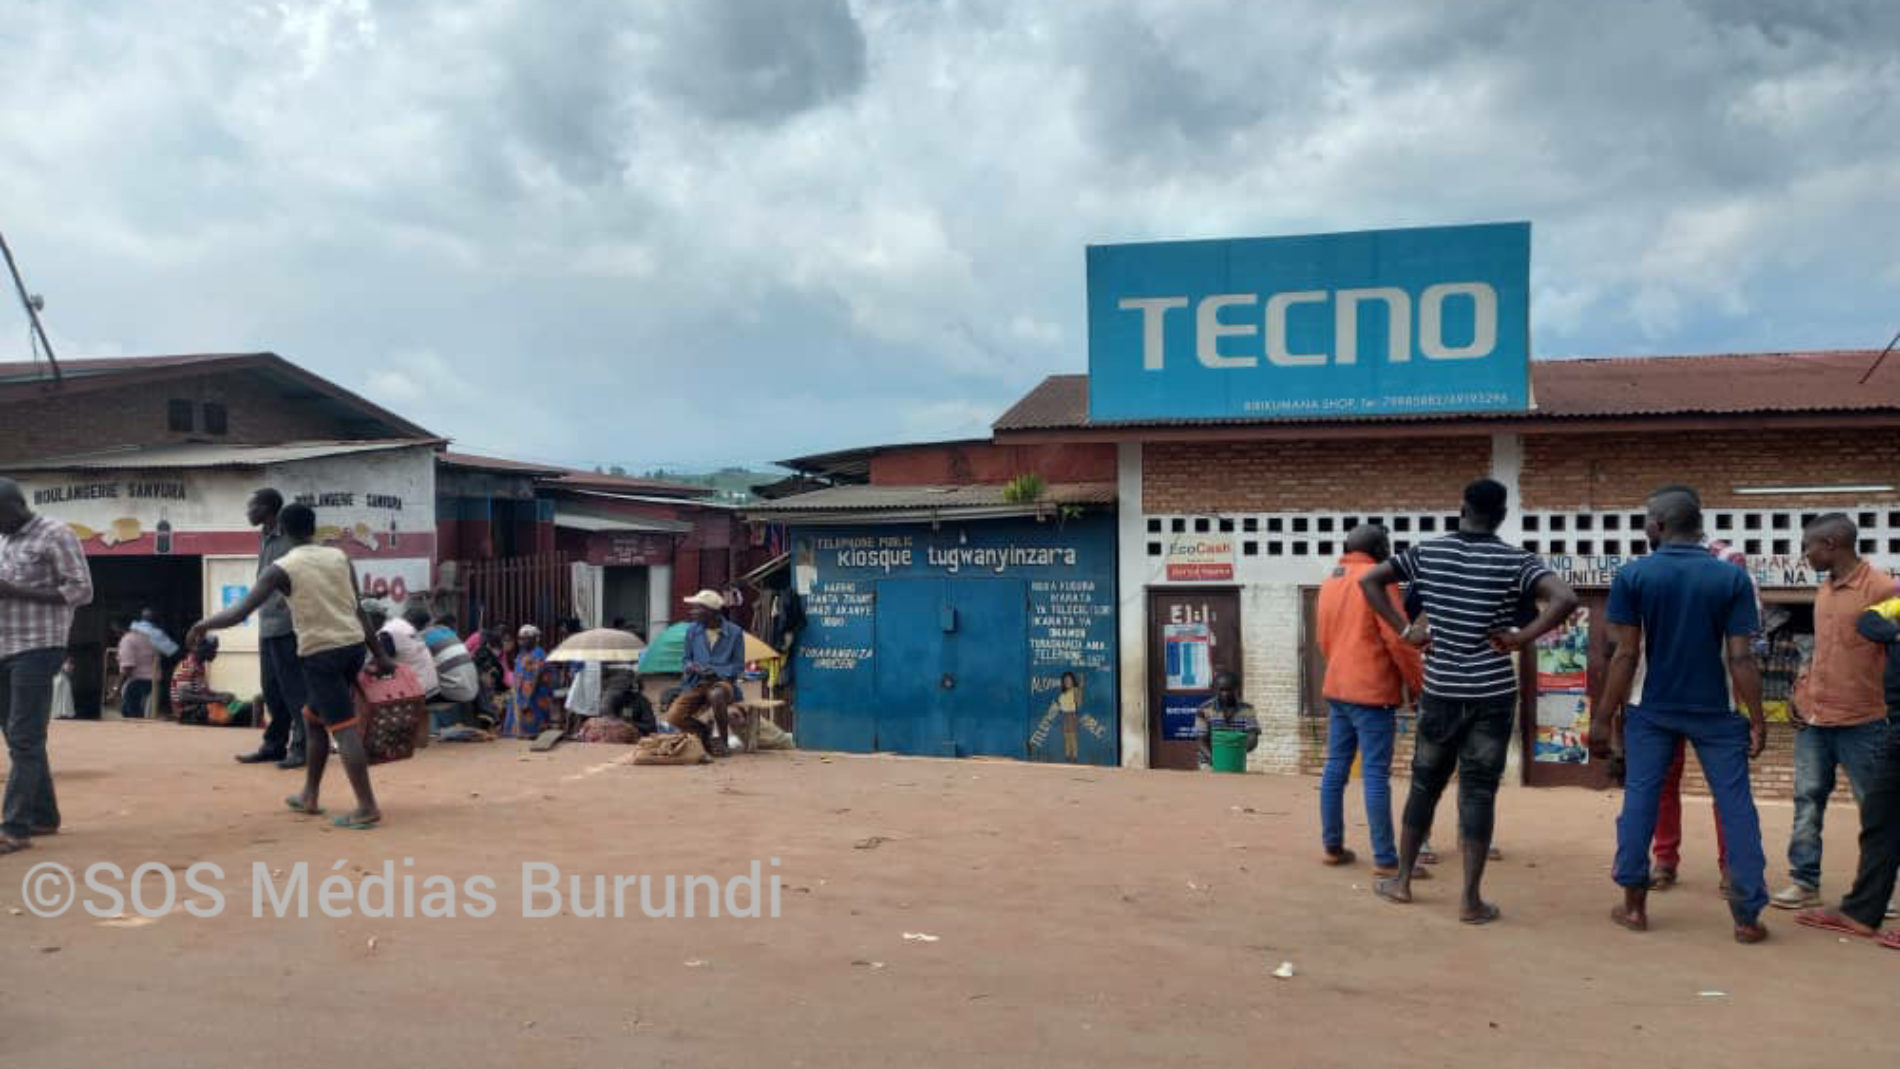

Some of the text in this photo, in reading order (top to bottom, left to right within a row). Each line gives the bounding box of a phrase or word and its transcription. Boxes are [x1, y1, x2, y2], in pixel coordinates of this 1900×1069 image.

[1118, 281, 1498, 371] TECNO
[928, 542, 1076, 573] tugwanyinzara
[1169, 542, 1232, 556] EcoCash
